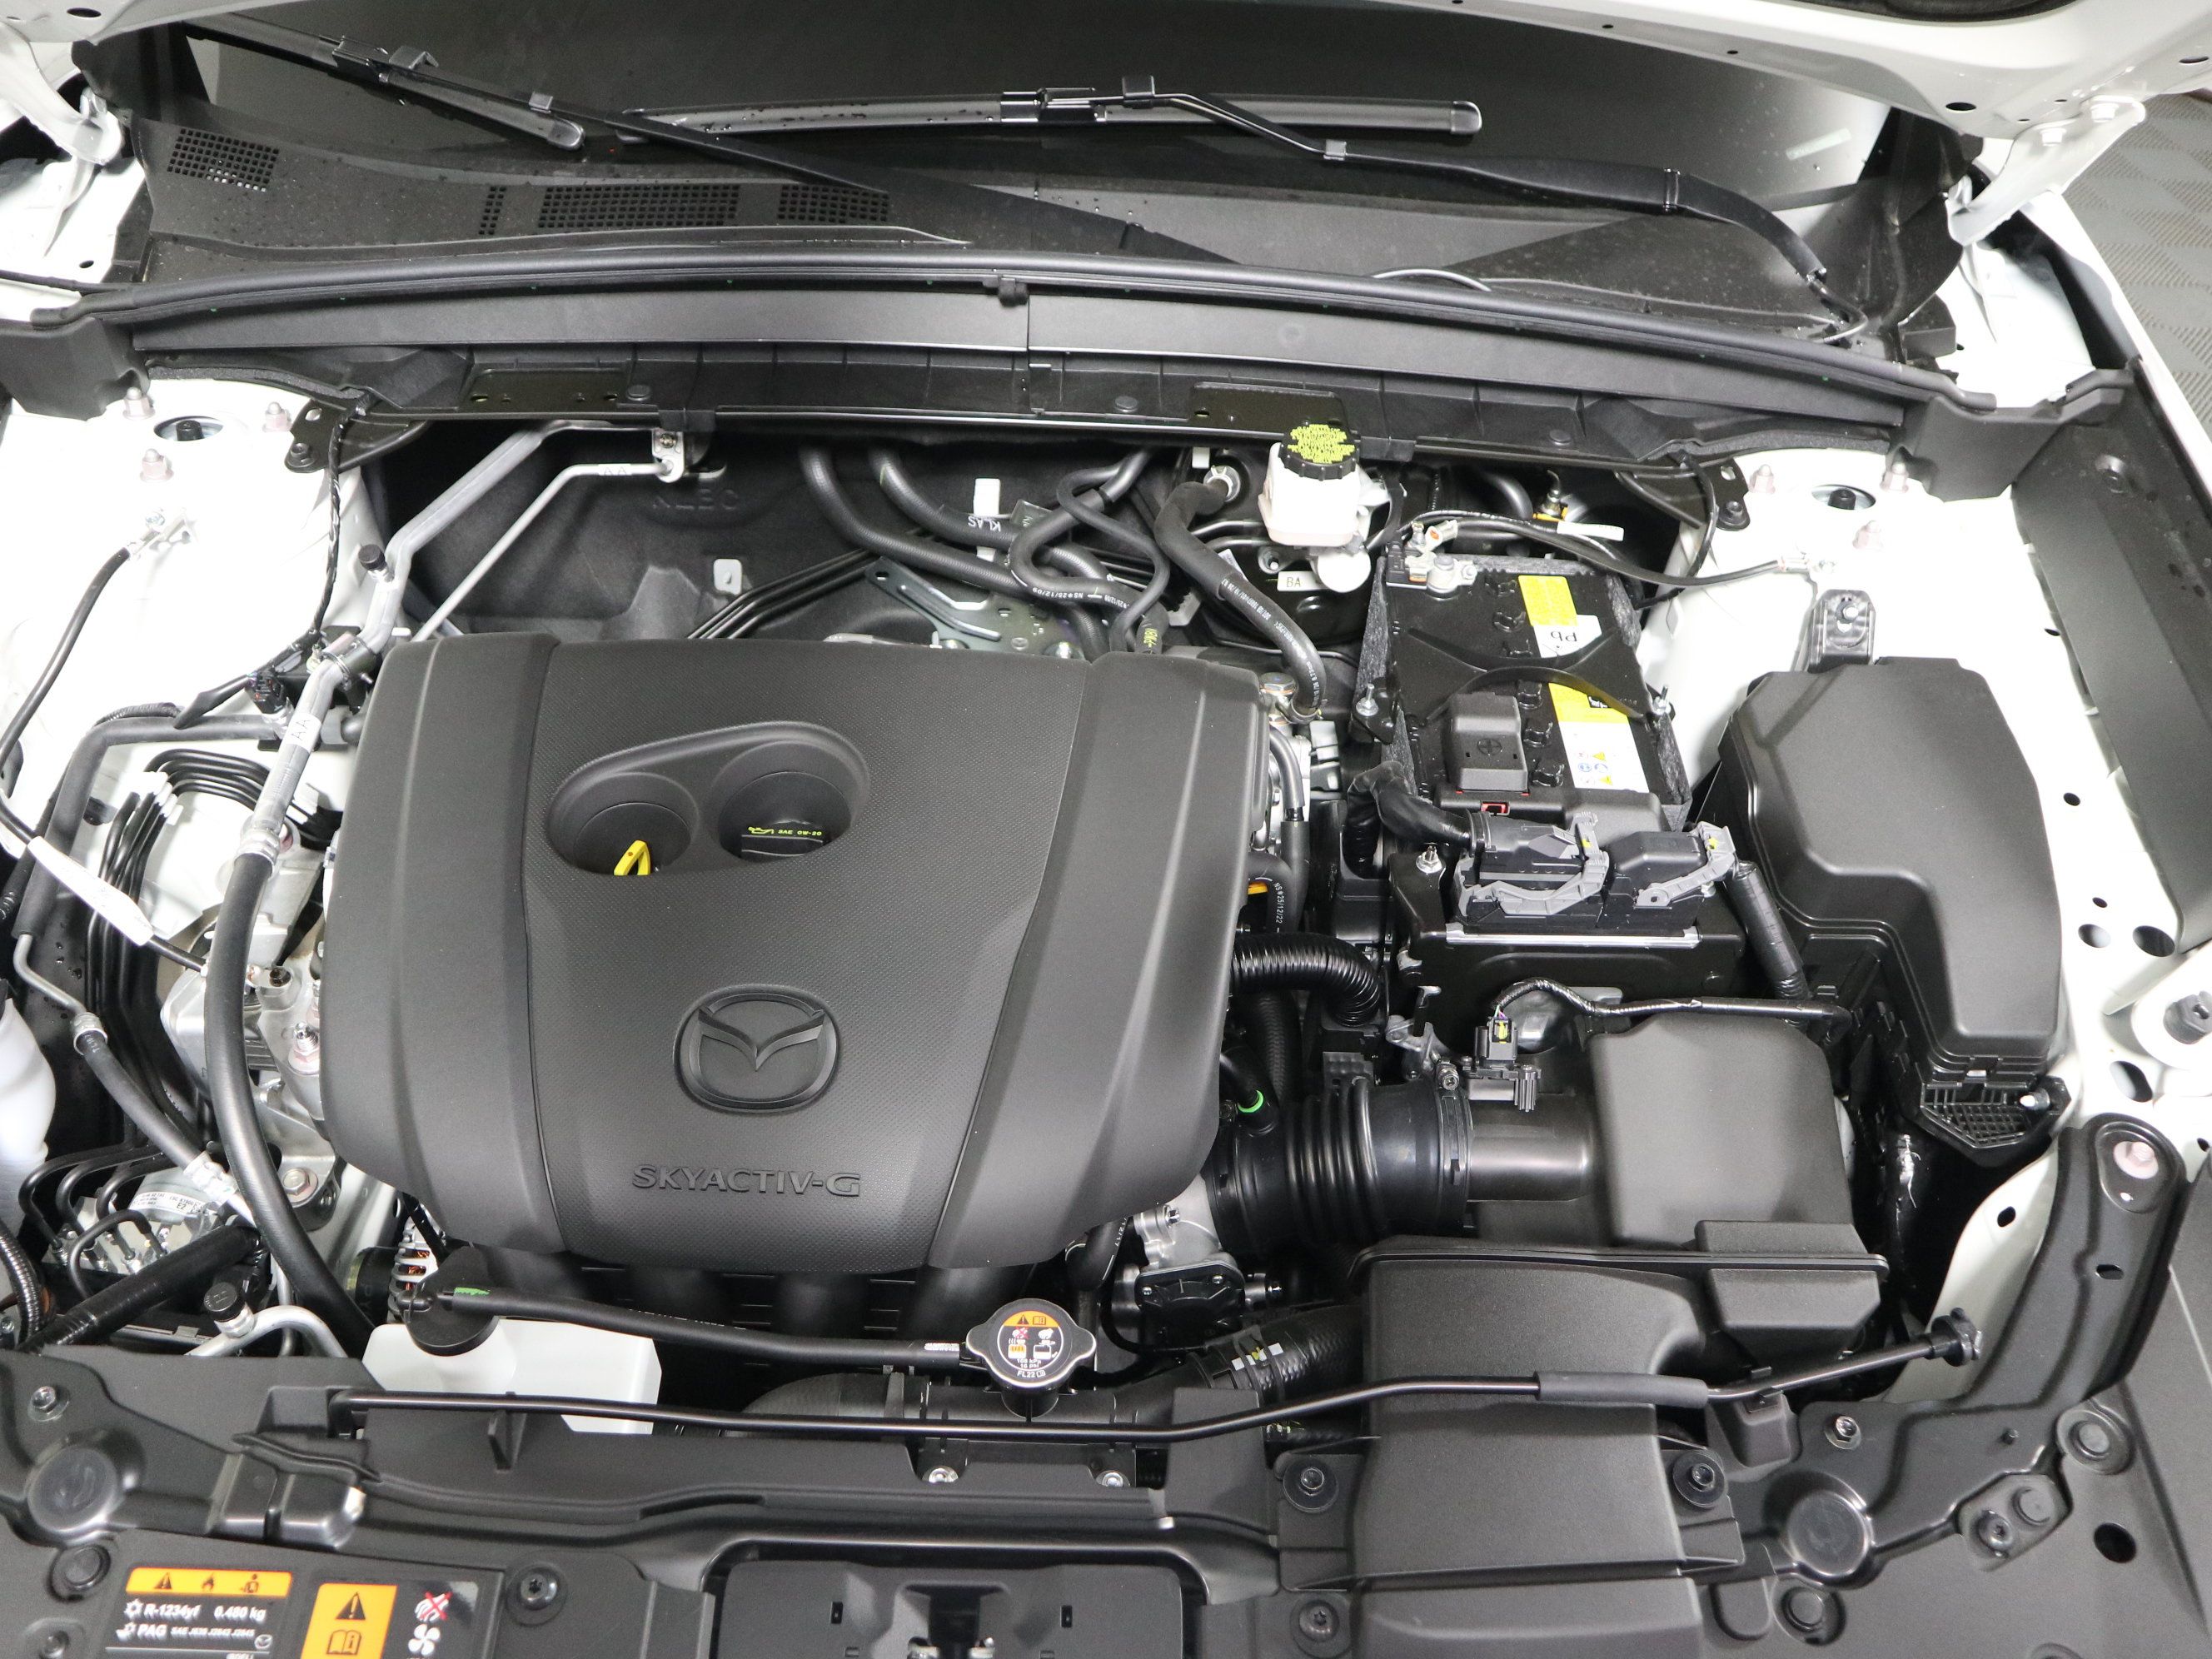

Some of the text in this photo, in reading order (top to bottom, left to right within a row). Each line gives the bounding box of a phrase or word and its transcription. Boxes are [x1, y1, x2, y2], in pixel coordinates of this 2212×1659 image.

[968, 515, 1002, 532] KLAS
[1286, 577, 1302, 587] BA
[631, 1163, 861, 1198] SKYACTIV-G
[143, 1603, 202, 1622] R-1234yf
[249, 1607, 267, 1624] kg
[137, 1624, 168, 1641] PAG
